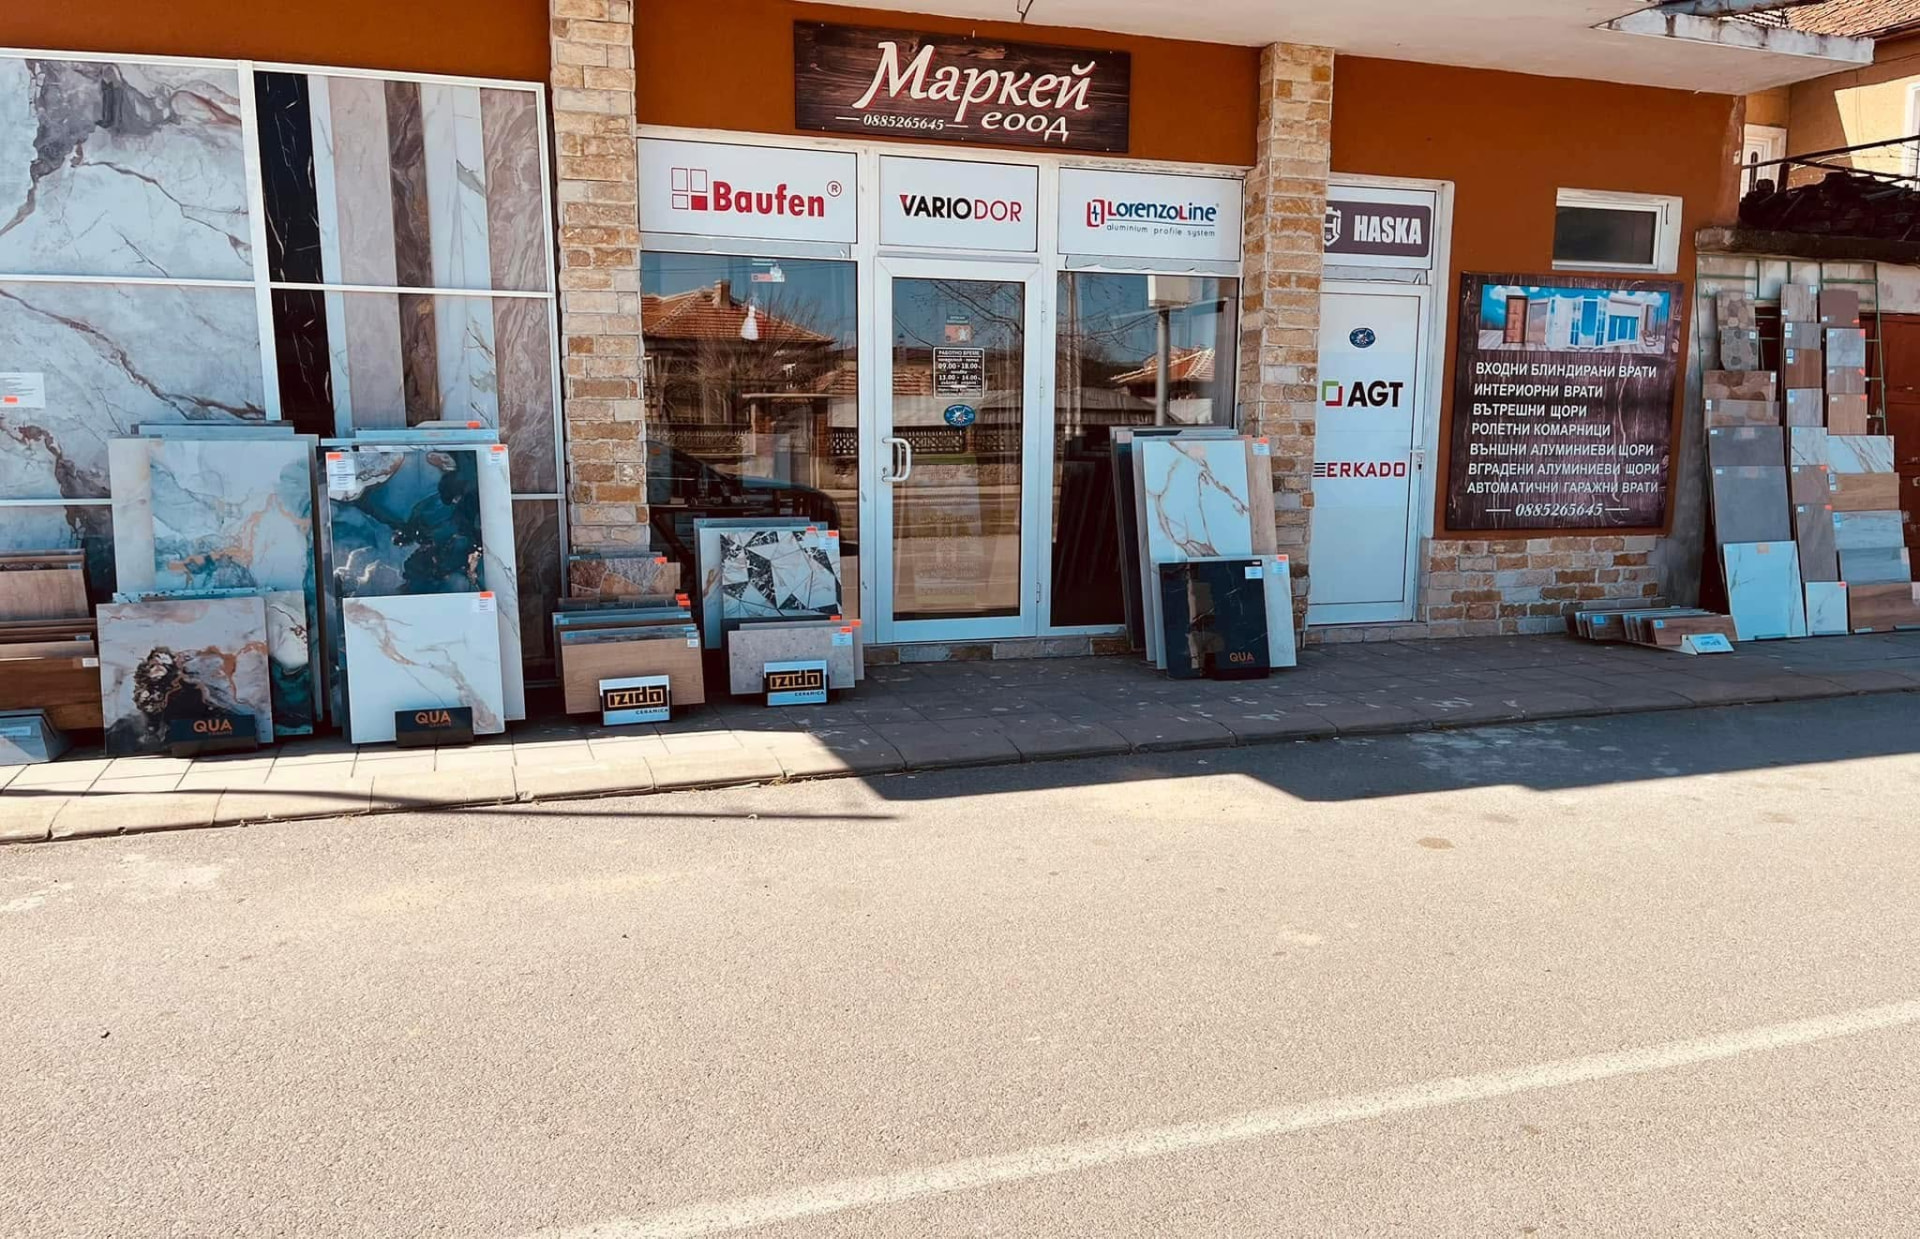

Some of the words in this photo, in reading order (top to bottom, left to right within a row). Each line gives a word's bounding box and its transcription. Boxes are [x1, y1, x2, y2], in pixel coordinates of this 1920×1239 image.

[852, 41, 1096, 122] Маркей
[863, 113, 945, 131] 0885265645
[713, 180, 825, 218] Baufen
[899, 193, 1022, 223] VARIODOR
[1106, 224, 1148, 233] aluminium
[1153, 226, 1183, 235] profile
[1187, 229, 1216, 238] system
[1353, 215, 1423, 244] HASKA
[1475, 362, 1528, 377] ВХОДНИ
[1531, 363, 1616, 378] БЛИНДИРАНИ
[1619, 365, 1657, 378] ВРАТИ
[1347, 380, 1404, 407] AGT
[1474, 383, 1559, 397] ИНТЕРИОРНИ
[1564, 385, 1604, 398] ВРАТИ
[1472, 403, 1546, 417] ВЪТРЕШНИ
[1551, 405, 1587, 419] ЩОРИ
[1471, 423, 1530, 436] РОЛЕТНИ
[1534, 424, 1611, 437] КОМАРНИЦИ
[1470, 443, 1527, 456] ВЪНШНИ
[1530, 444, 1615, 456] АЛУМИНИЕВИ
[1619, 445, 1654, 458] ЩОРИ
[1327, 462, 1406, 478] ERKADO
[1468, 463, 1534, 476] ВГРАДЕНИ
[1537, 463, 1621, 475] АЛУМИНИЕВИ
[1625, 464, 1660, 476] ЩОРИ
[1467, 482, 1559, 494] АВТОМАТИЧНИ
[1563, 482, 1618, 493] ГАРАЖНИ
[1622, 482, 1659, 493] ВРАТИ
[1515, 503, 1604, 517] 0885265645
[1229, 652, 1255, 663] QUA
[415, 710, 451, 724] QUA
[193, 718, 233, 733] QUA
